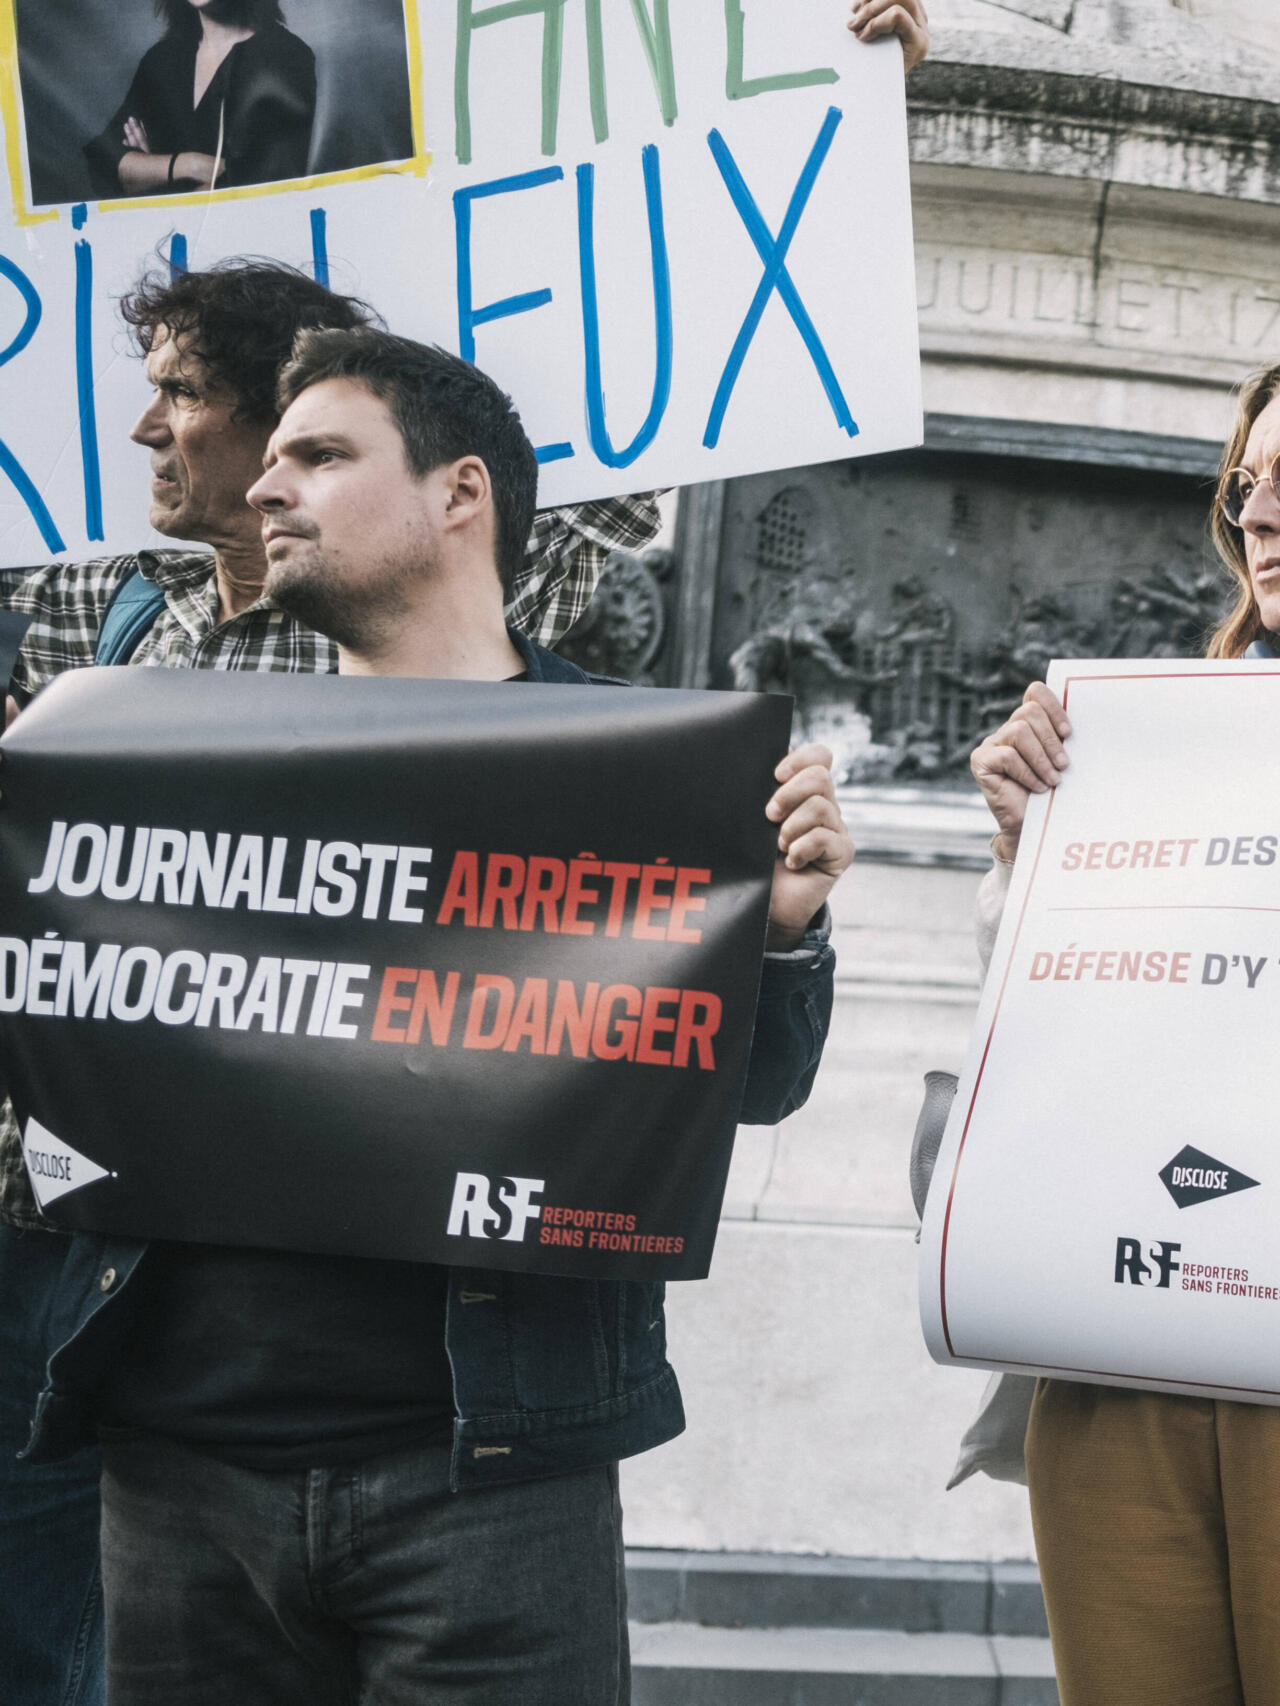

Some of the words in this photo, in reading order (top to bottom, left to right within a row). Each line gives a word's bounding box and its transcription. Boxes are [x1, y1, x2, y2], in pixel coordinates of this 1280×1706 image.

[917, 258, 1200, 339] JUILLET
[1061, 839, 1198, 872] SECRET
[1205, 835, 1277, 867] DES
[27, 820, 433, 923] JOURNALISTE
[436, 850, 712, 944] ARRÊTÉE
[1028, 943, 1192, 984] DÉFENSE
[0, 931, 371, 1040] DÉMOCRATIE
[371, 966, 462, 1047] EN
[463, 973, 723, 1071] DANGER
[446, 1172, 546, 1242] RSF
[542, 1206, 637, 1232] REPORTERS
[539, 1227, 584, 1249] SANS
[588, 1231, 685, 1254] FRONTIERES
[1114, 1236, 1182, 1289] RSF
[1182, 1262, 1249, 1282] REPORTERS
[1181, 1278, 1213, 1294] SANS
